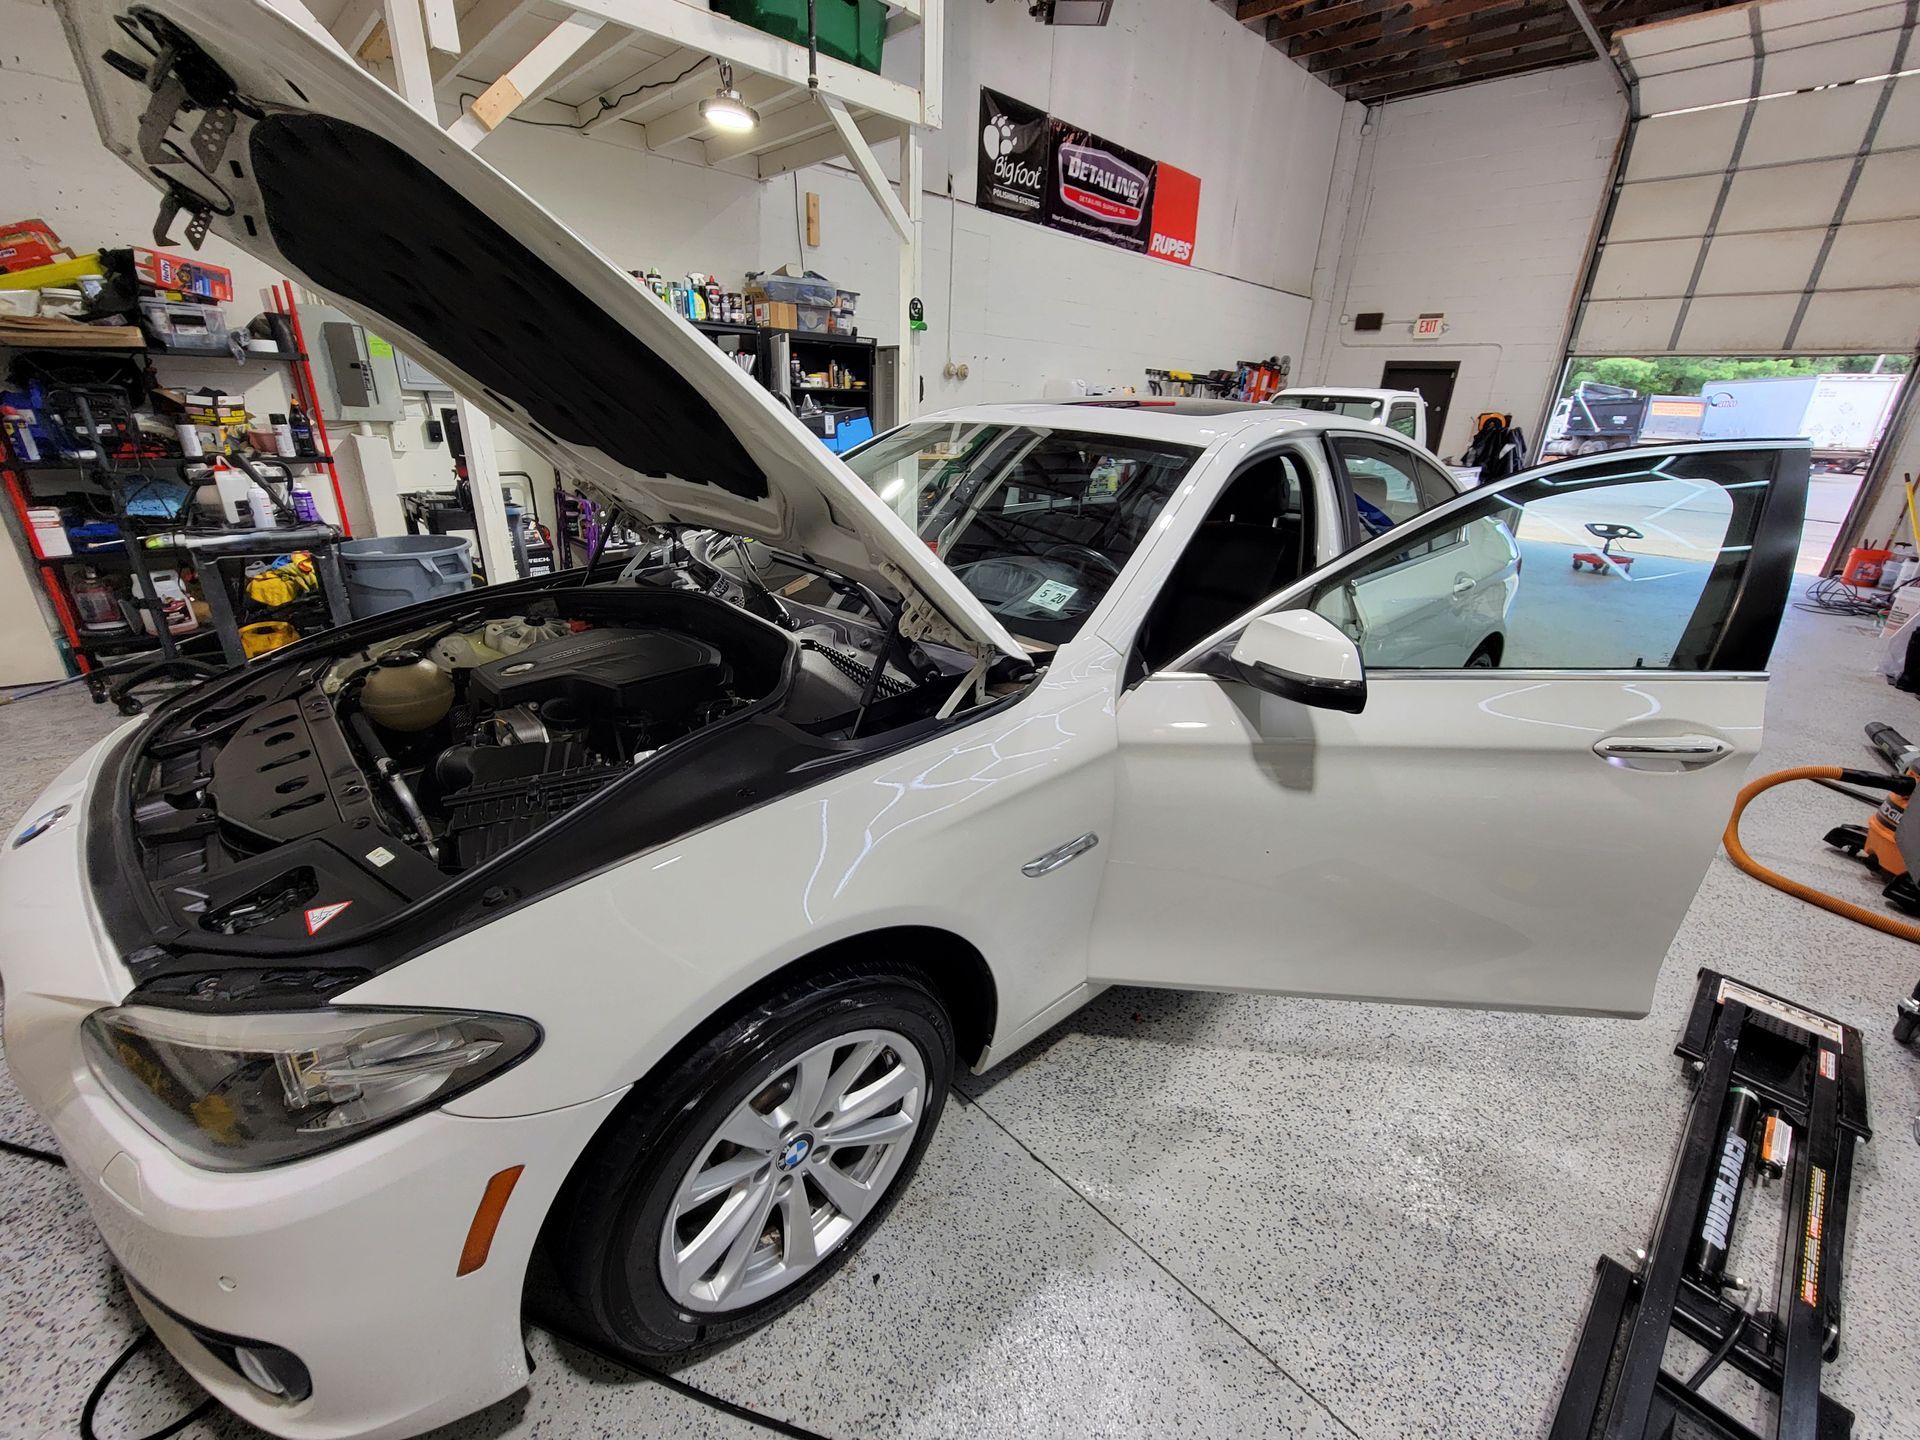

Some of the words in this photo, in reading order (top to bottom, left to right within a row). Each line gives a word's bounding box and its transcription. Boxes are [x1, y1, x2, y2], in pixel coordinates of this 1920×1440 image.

[1067, 155, 1140, 199] DETAILING
[1151, 232, 1192, 260] RUPES
[1419, 320, 1439, 333] EXIT
[1039, 589, 1051, 598] 5
[1050, 592, 1067, 604] 20
[1701, 1130, 1748, 1251] QUICKJACK
